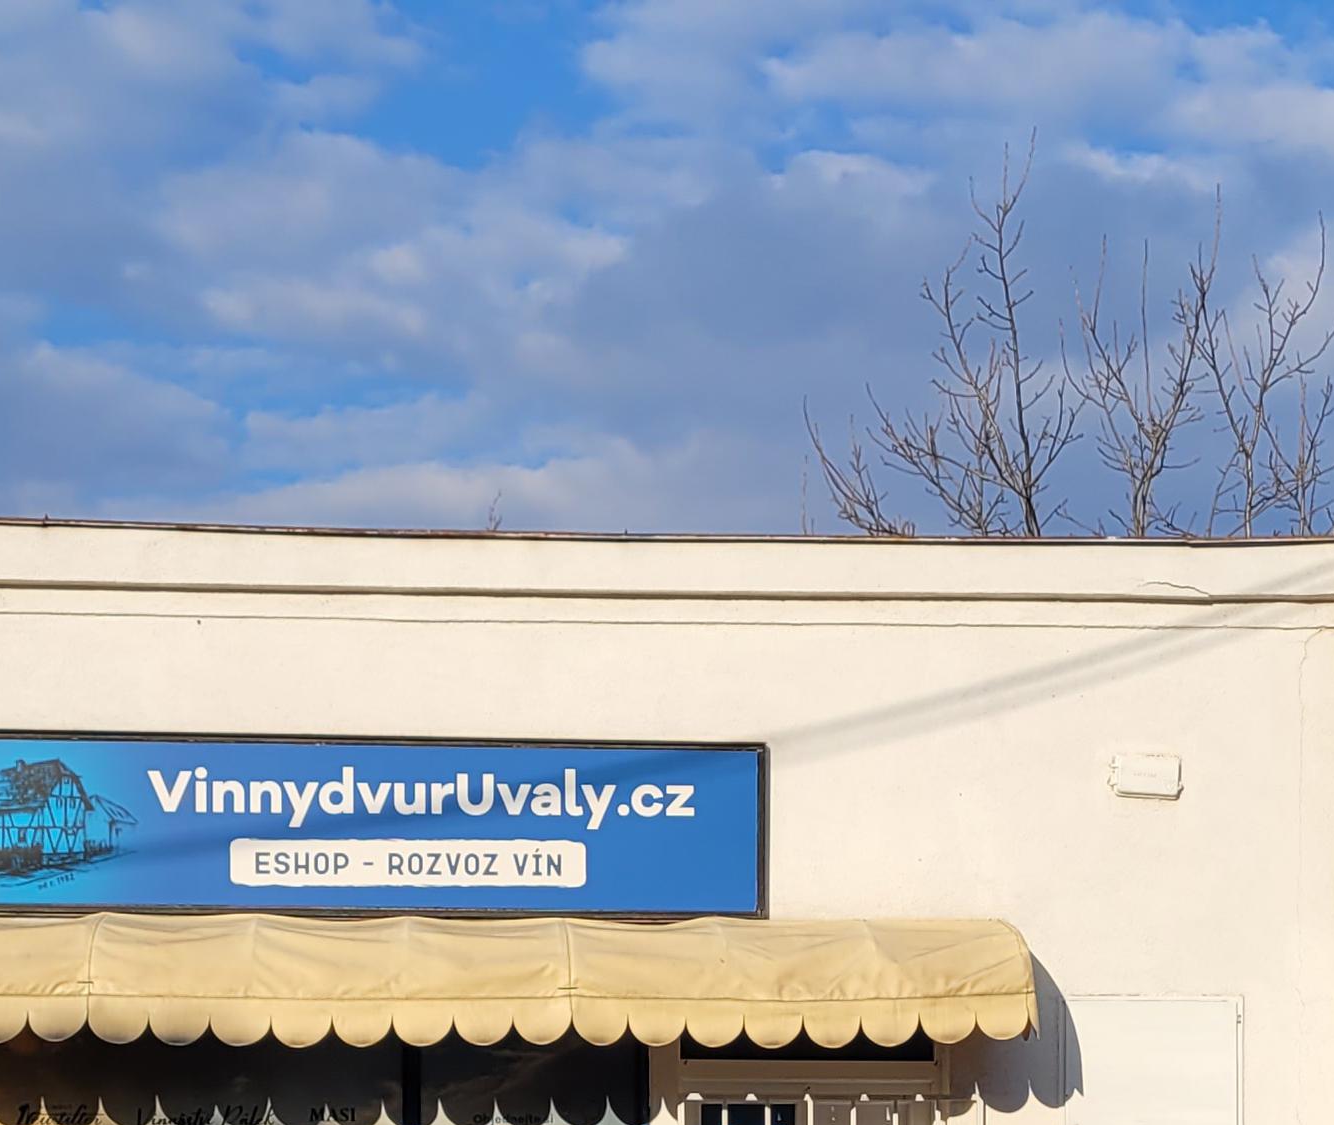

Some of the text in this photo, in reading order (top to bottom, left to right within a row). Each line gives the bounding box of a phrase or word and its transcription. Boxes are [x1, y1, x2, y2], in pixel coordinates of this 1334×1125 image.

[147, 767, 695, 830] VinnydvurUvaly.cz
[254, 852, 349, 875] ESHOP
[387, 852, 499, 876] ROZVOZ
[512, 848, 562, 876] VÍN
[309, 1107, 356, 1122] MASI
